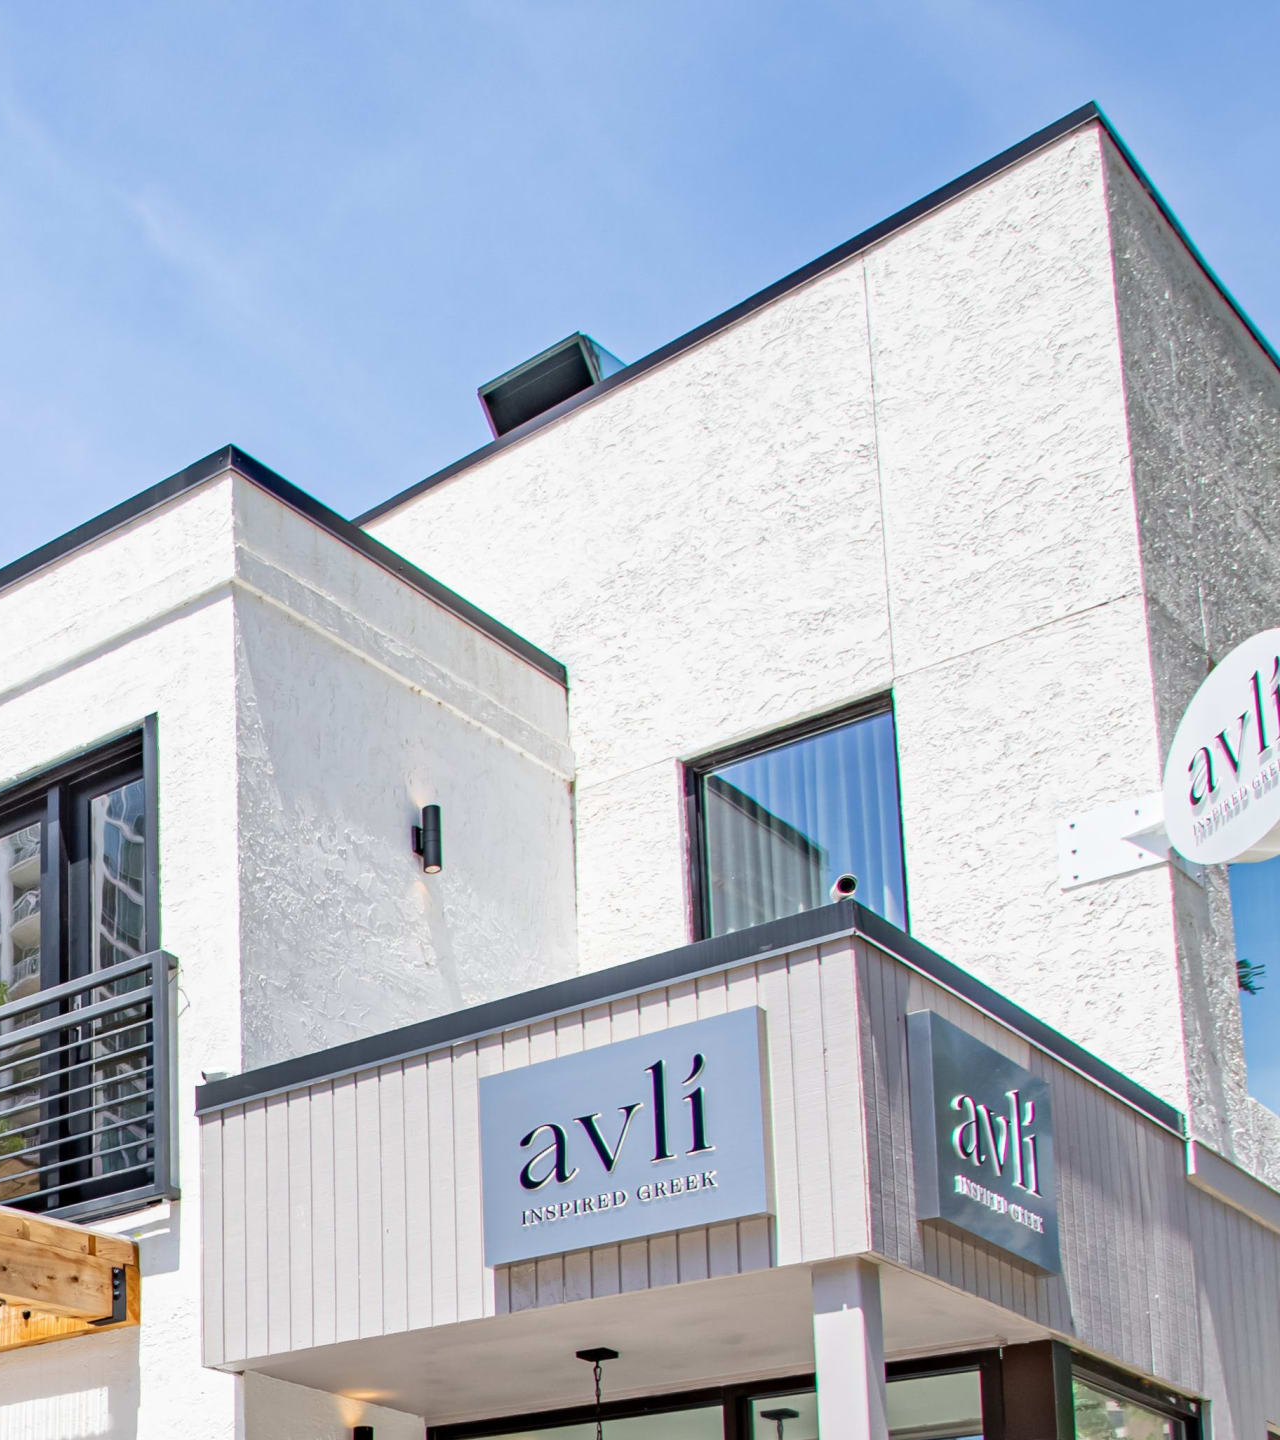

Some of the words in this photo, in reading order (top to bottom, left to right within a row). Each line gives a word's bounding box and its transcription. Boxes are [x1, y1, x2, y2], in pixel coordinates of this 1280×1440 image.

[520, 1189, 628, 1227] INSPIRED
[636, 1169, 718, 1202] GREEK
[953, 1174, 1008, 1214] INSPIRED
[1008, 1203, 1044, 1234] GREEK
